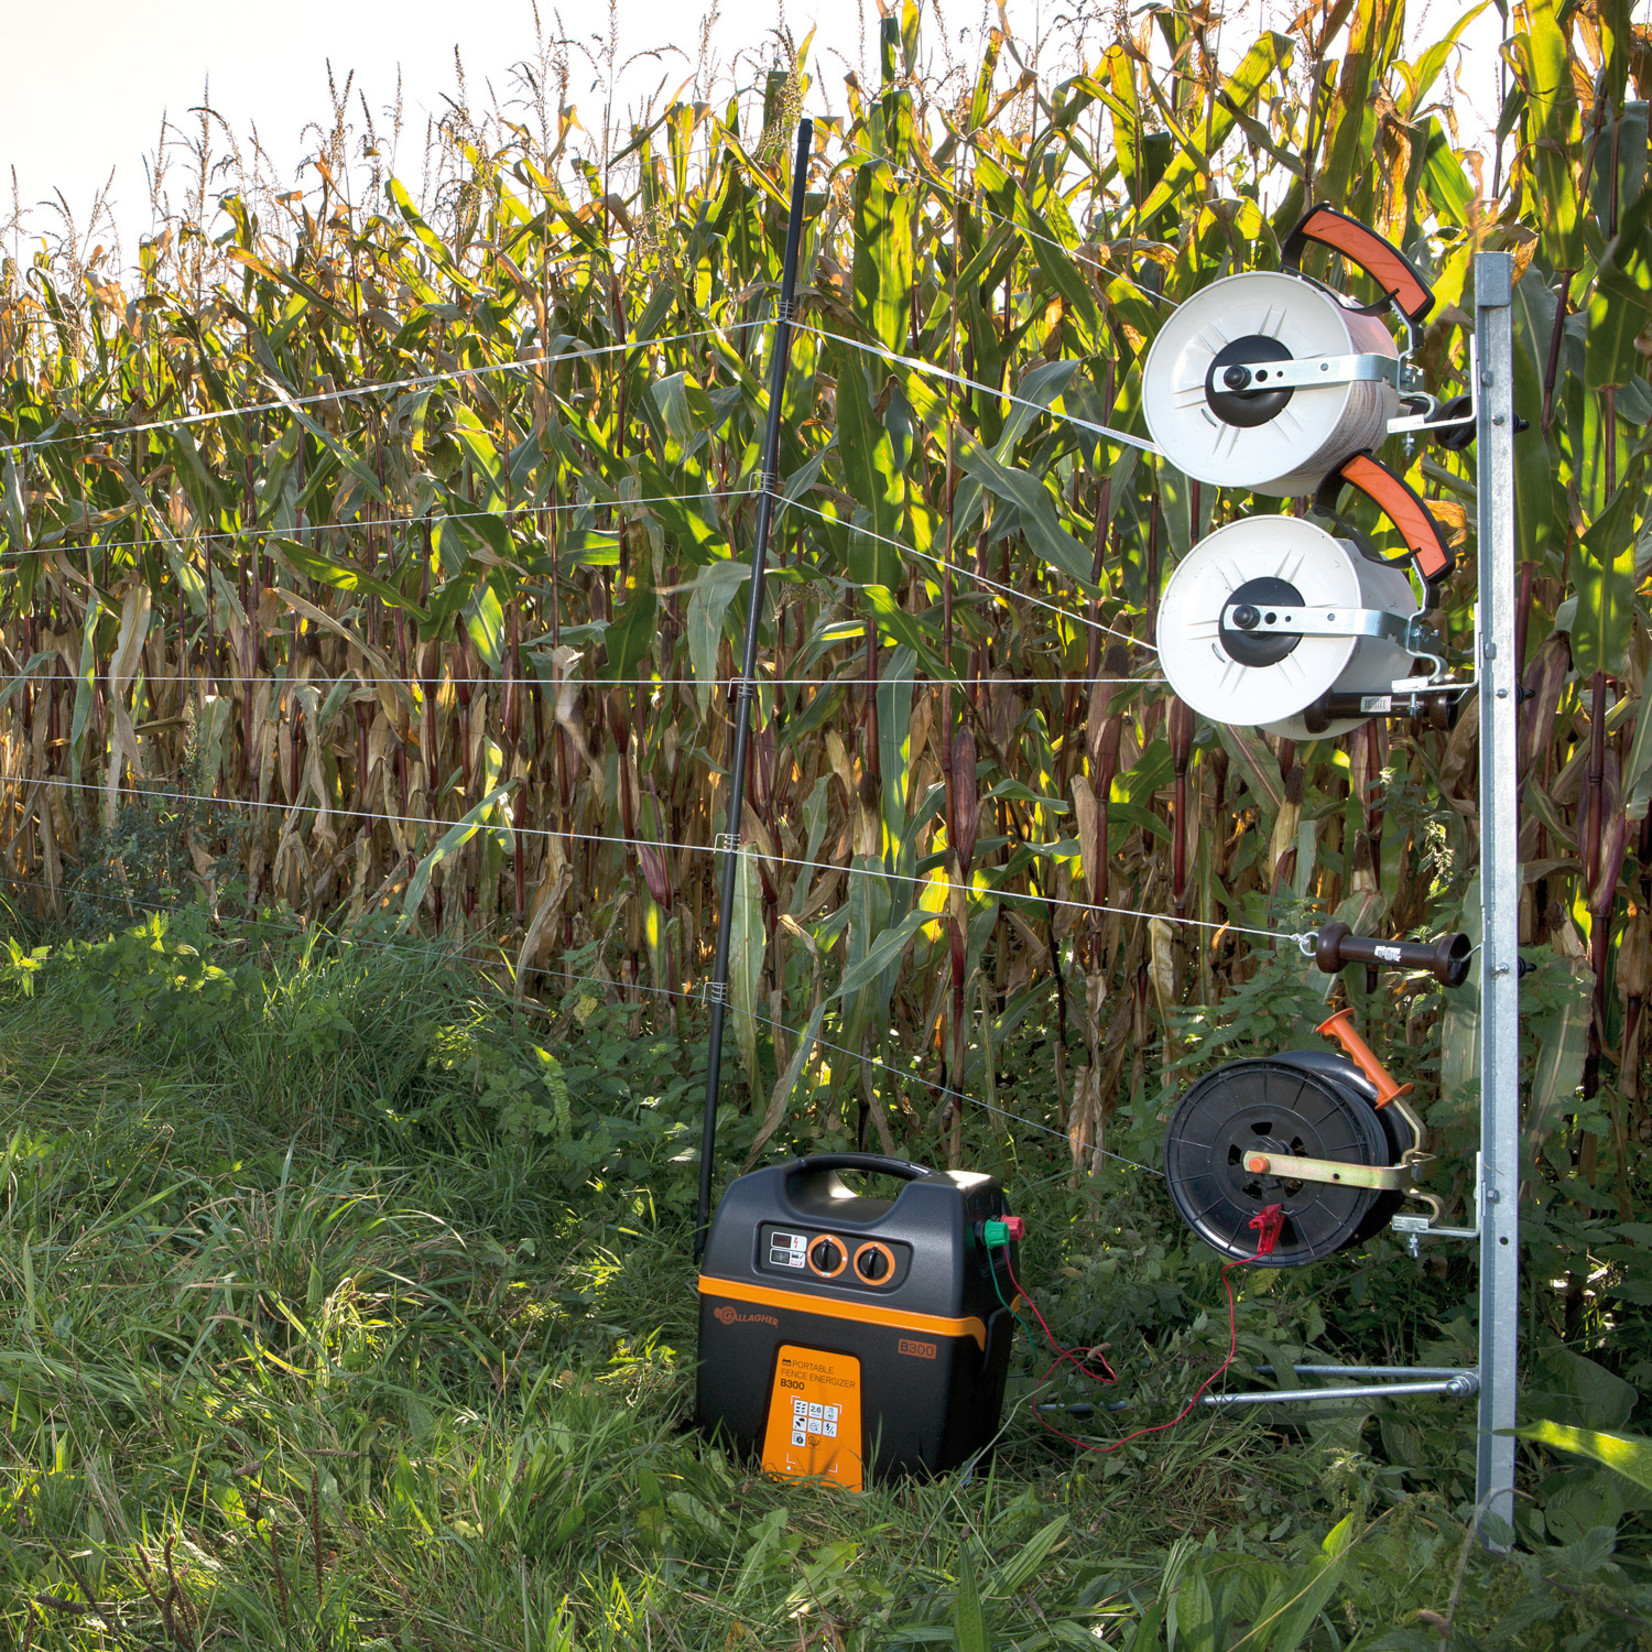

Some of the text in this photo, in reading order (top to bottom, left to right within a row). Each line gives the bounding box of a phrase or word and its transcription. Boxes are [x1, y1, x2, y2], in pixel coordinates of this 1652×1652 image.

[722, 1310, 779, 1328] GALLAGHER
[900, 1341, 934, 1357] B300
[792, 1360, 834, 1374] PORTABLE
[780, 1378, 805, 1390] B300
[781, 1368, 856, 1389] FENCE ENERGIZER
